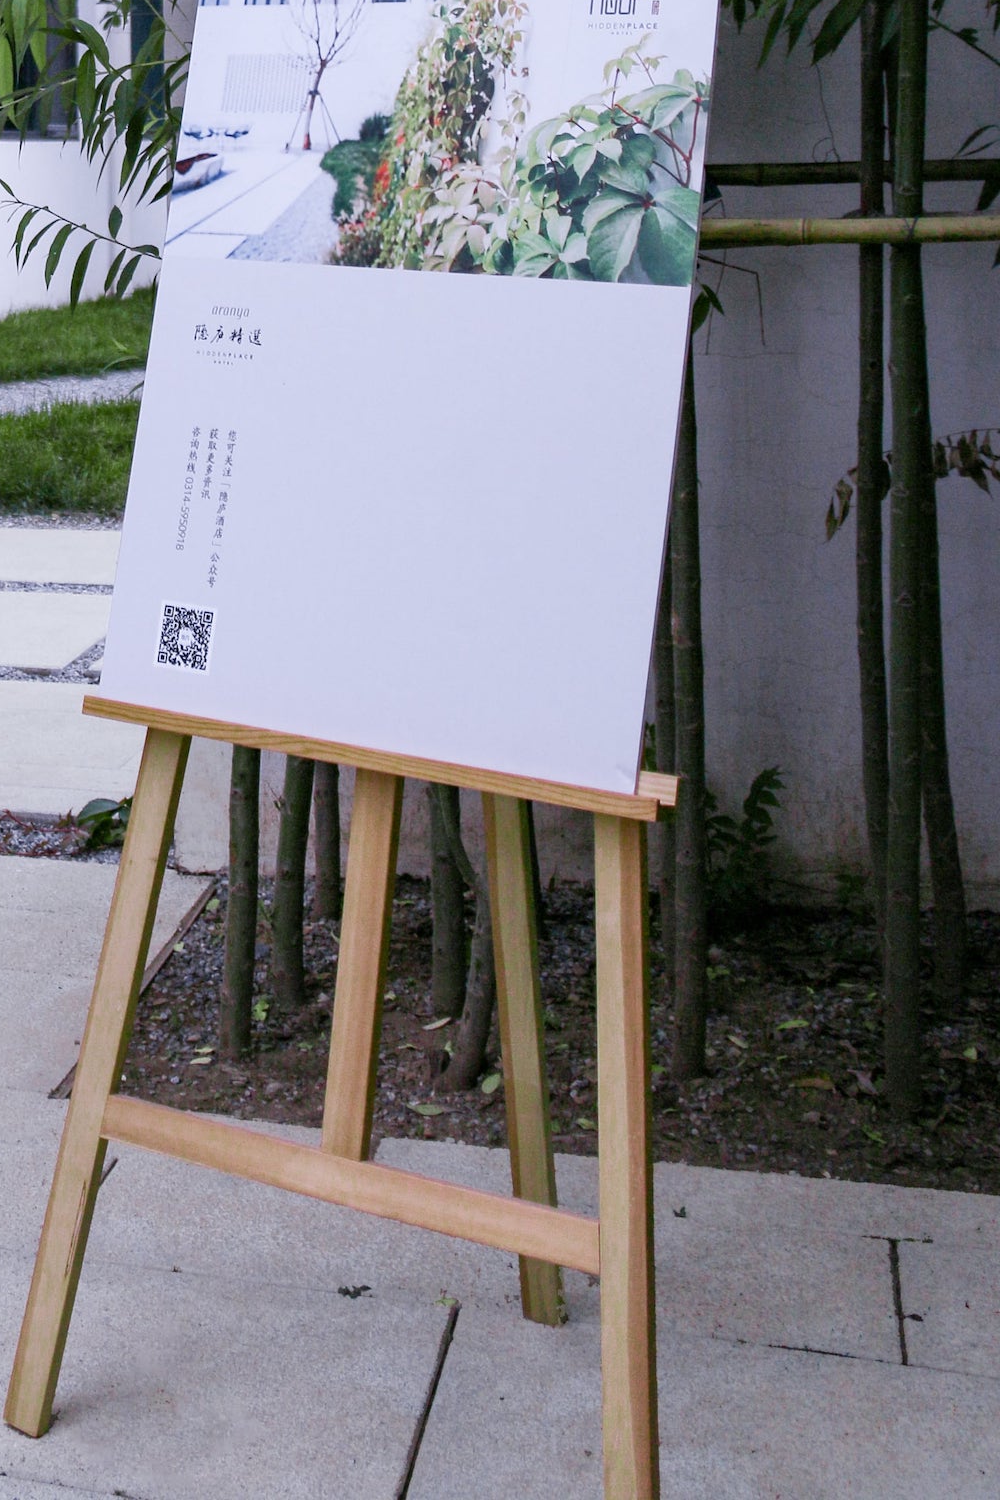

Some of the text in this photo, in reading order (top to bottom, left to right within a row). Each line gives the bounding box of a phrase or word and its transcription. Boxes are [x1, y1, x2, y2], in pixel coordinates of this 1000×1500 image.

[587, 22, 659, 30] HIDDENPLACE
[211, 305, 250, 320] aranya
[175, 426, 201, 551] 咨询热线 0314-5950918
